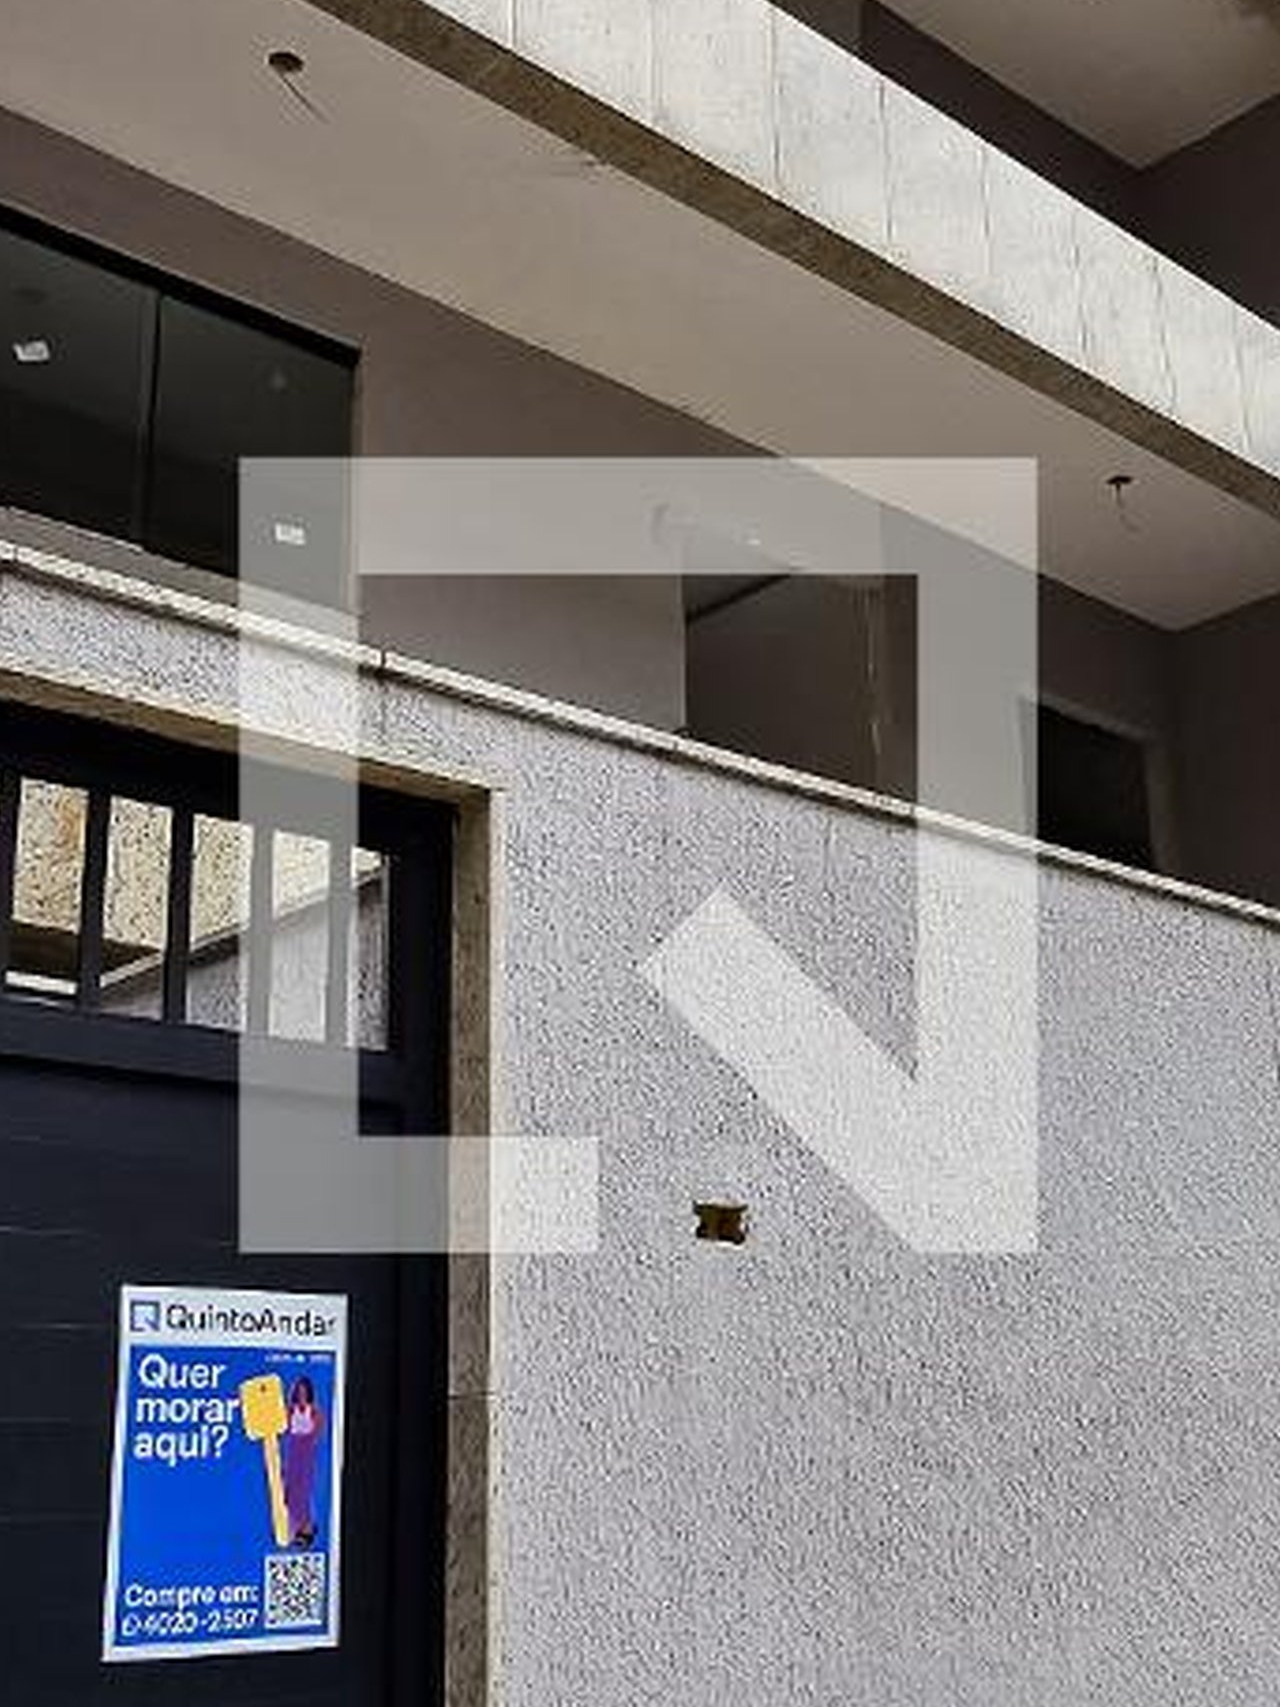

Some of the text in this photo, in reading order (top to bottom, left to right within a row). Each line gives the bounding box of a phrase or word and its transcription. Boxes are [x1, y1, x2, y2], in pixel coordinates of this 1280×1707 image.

[166, 1304, 337, 1337] QuintoAndar
[138, 1353, 227, 1389] Quer
[136, 1397, 240, 1423] morar
[133, 1424, 229, 1467] aqui?
